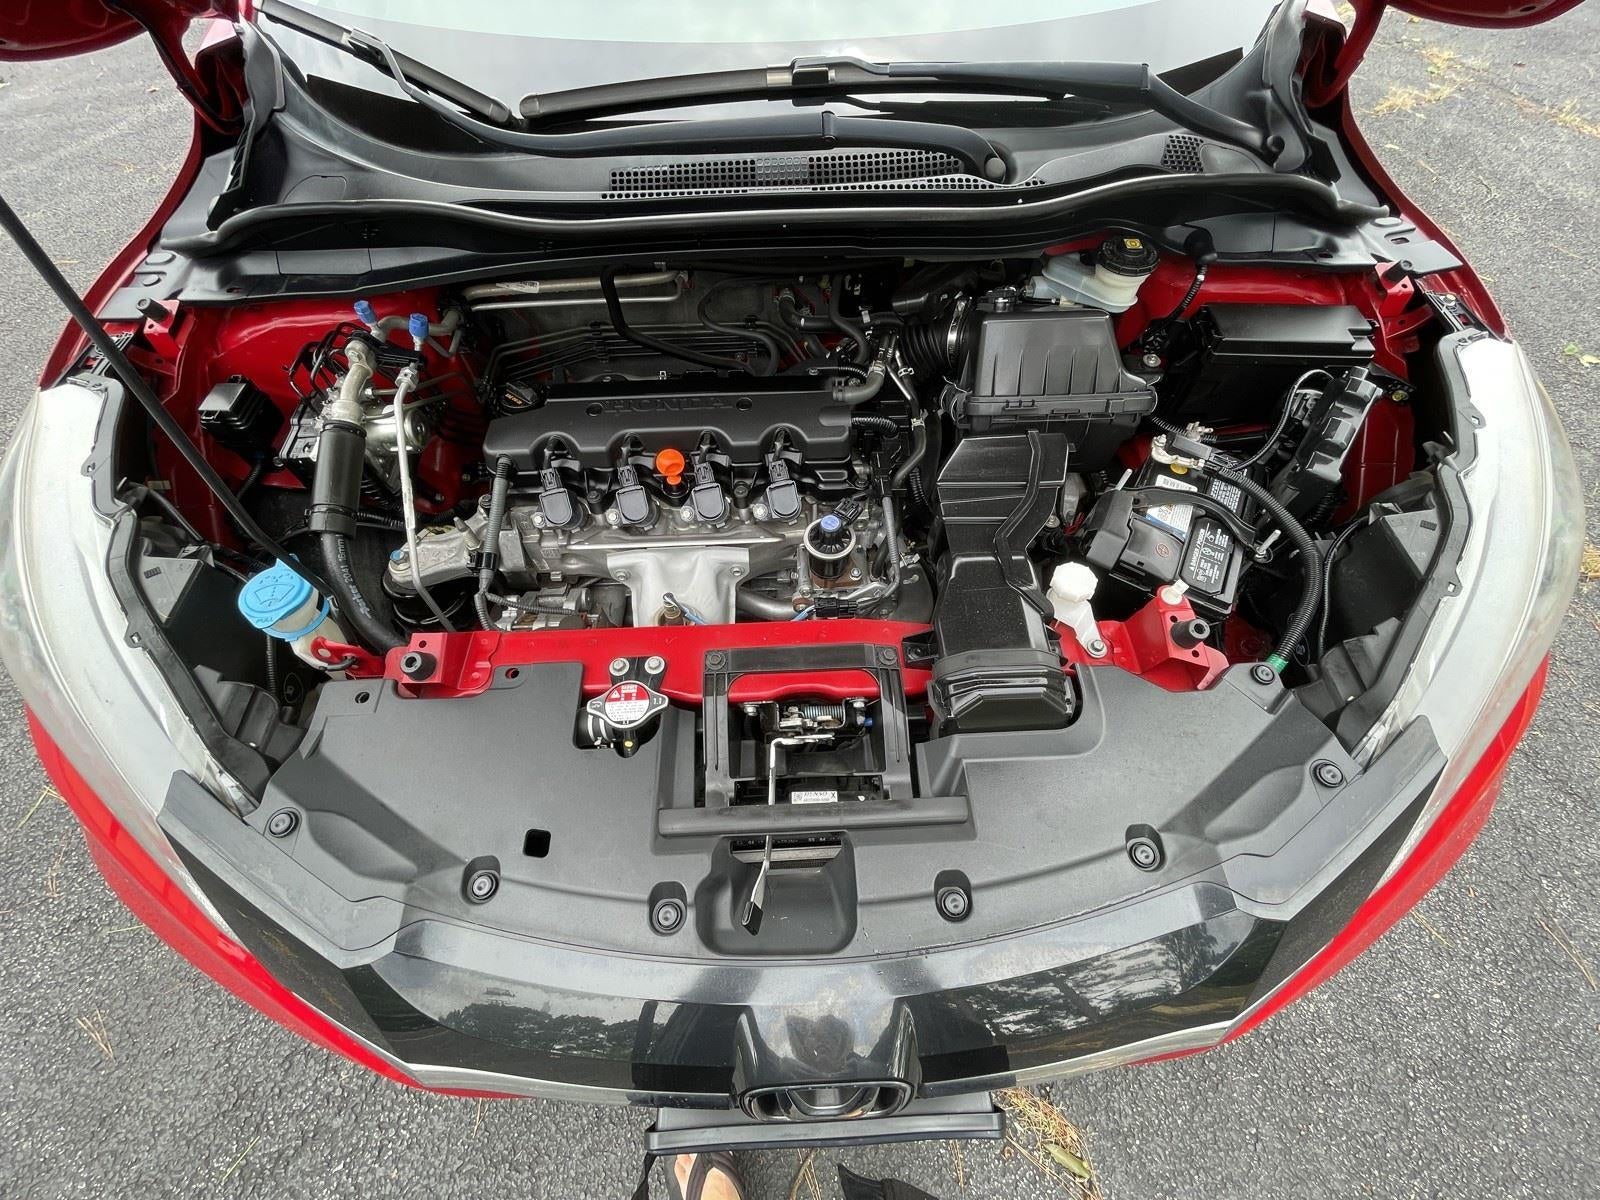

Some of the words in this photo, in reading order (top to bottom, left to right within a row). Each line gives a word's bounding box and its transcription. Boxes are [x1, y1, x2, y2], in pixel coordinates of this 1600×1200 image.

[604, 397, 733, 413] HONDA
[337, 539, 346, 561] 16mm
[340, 565, 353, 583] 2041
